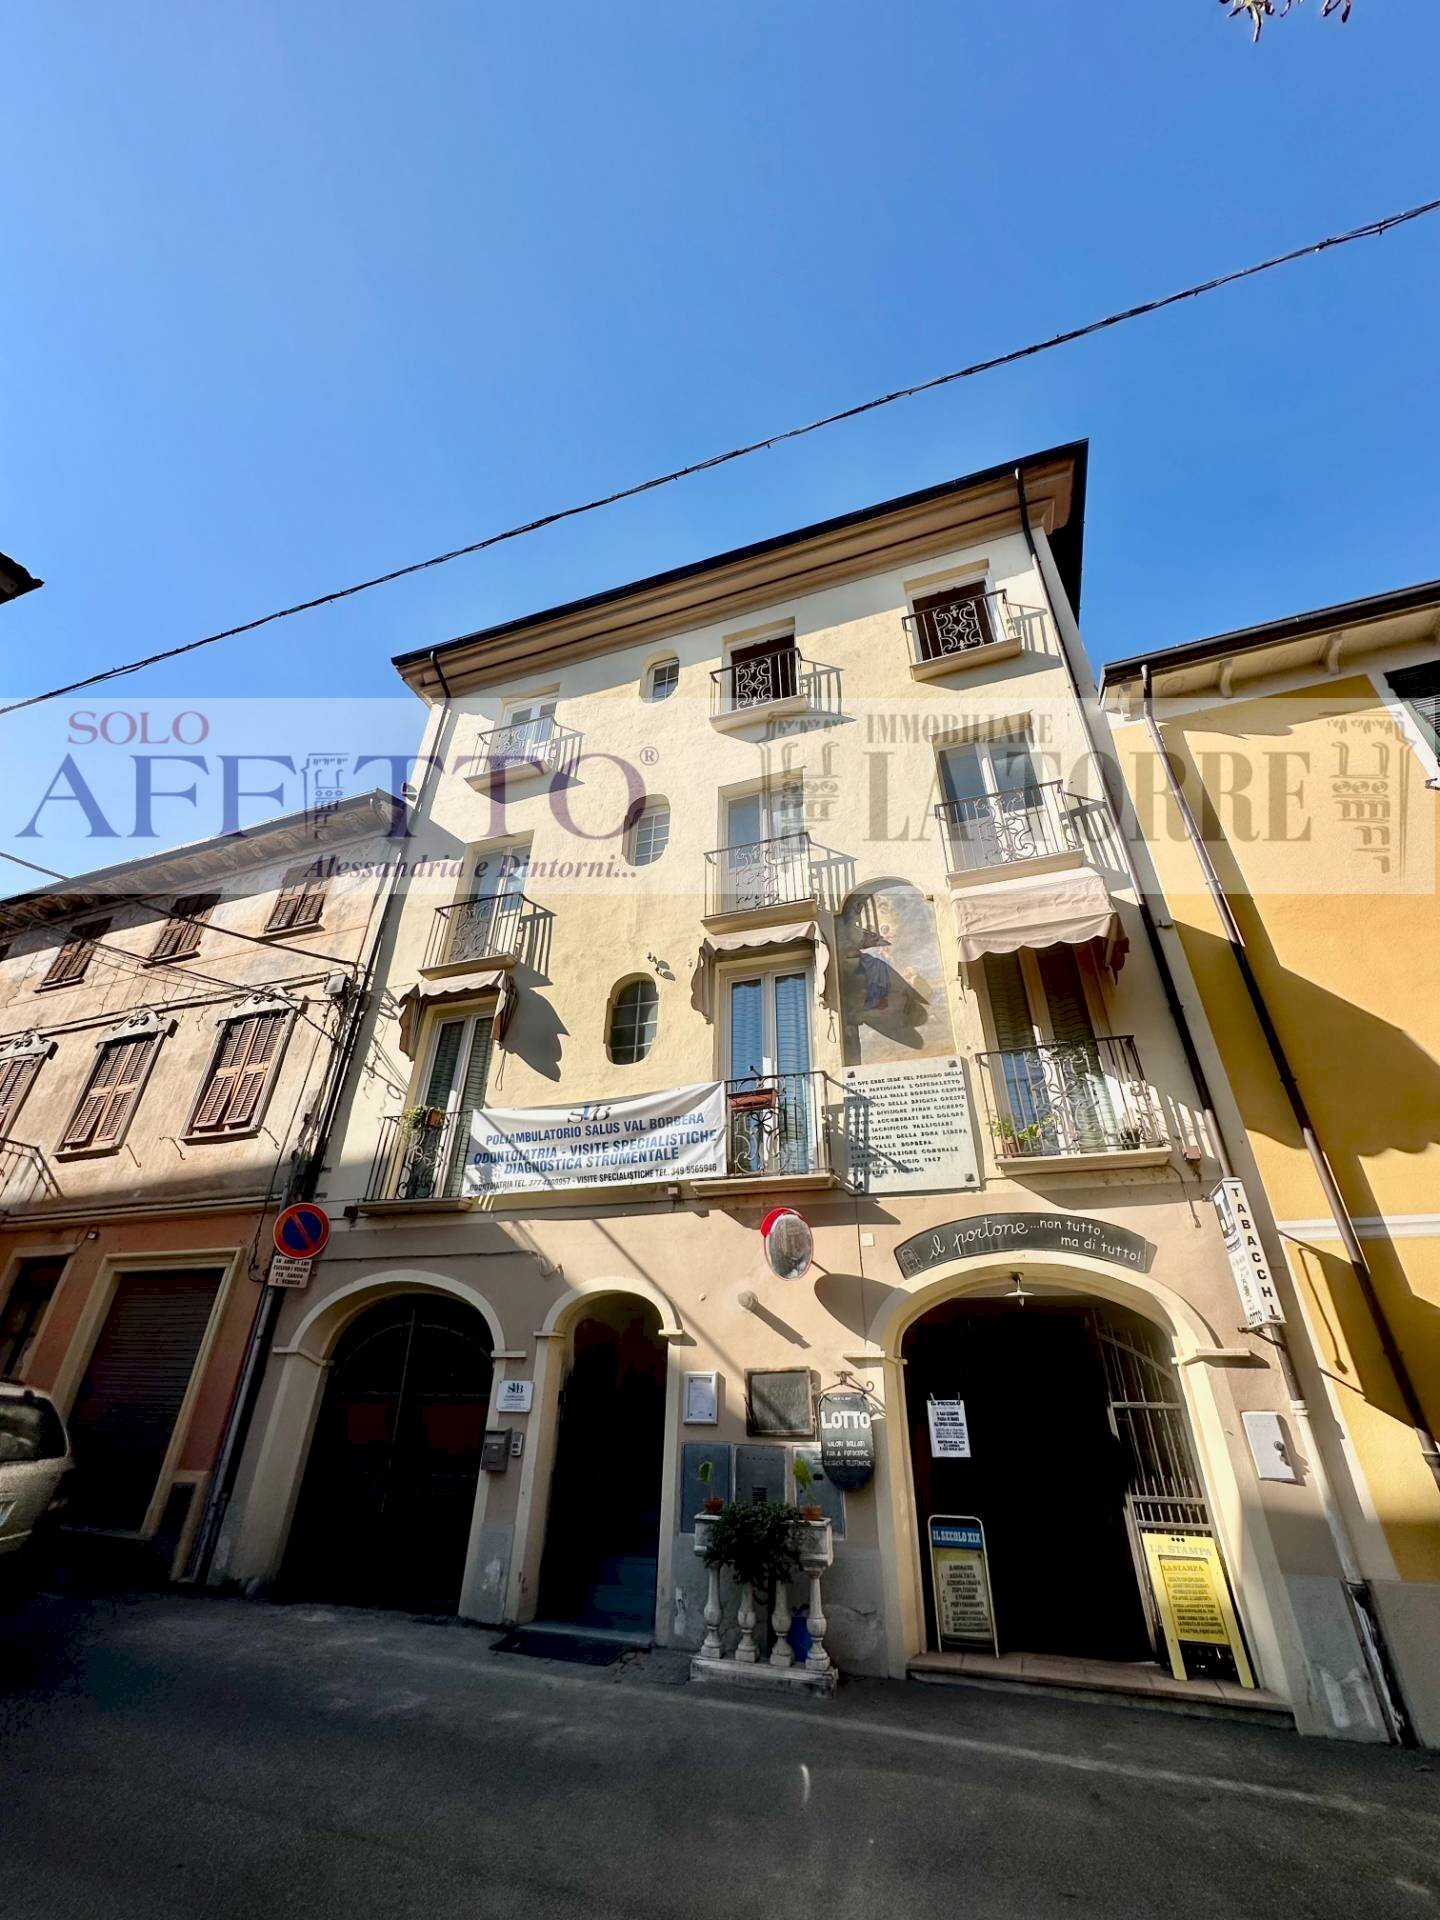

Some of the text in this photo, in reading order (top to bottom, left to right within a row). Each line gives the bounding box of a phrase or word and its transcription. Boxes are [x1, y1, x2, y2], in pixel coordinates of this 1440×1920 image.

[486, 1126, 581, 1145] POLIAMBULATORIO
[585, 1122, 620, 1136] SALUS
[624, 1119, 646, 1132] VAL
[473, 1147, 557, 1164] ODONTOIATRIA
[570, 1141, 609, 1156] VISITE
[613, 1129, 718, 1153] SPECIALISTICHE
[504, 1147, 679, 1175] DIAGNOSTICA STRUMENTALE
[576, 1174, 598, 1183] VISITE
[599, 1168, 654, 1182] SPECIALISTICHE
[952, 1217, 1029, 1255] portone
[1060, 1236, 1079, 1247] ma
[1083, 1238, 1097, 1249] di
[1231, 1187, 1276, 1316] TABACCHI
[820, 1410, 871, 1429] LOTTO
[932, 1530, 940, 1540] IL
[967, 1532, 981, 1543] XIX
[1150, 1544, 1212, 1556] LA STAMPA
